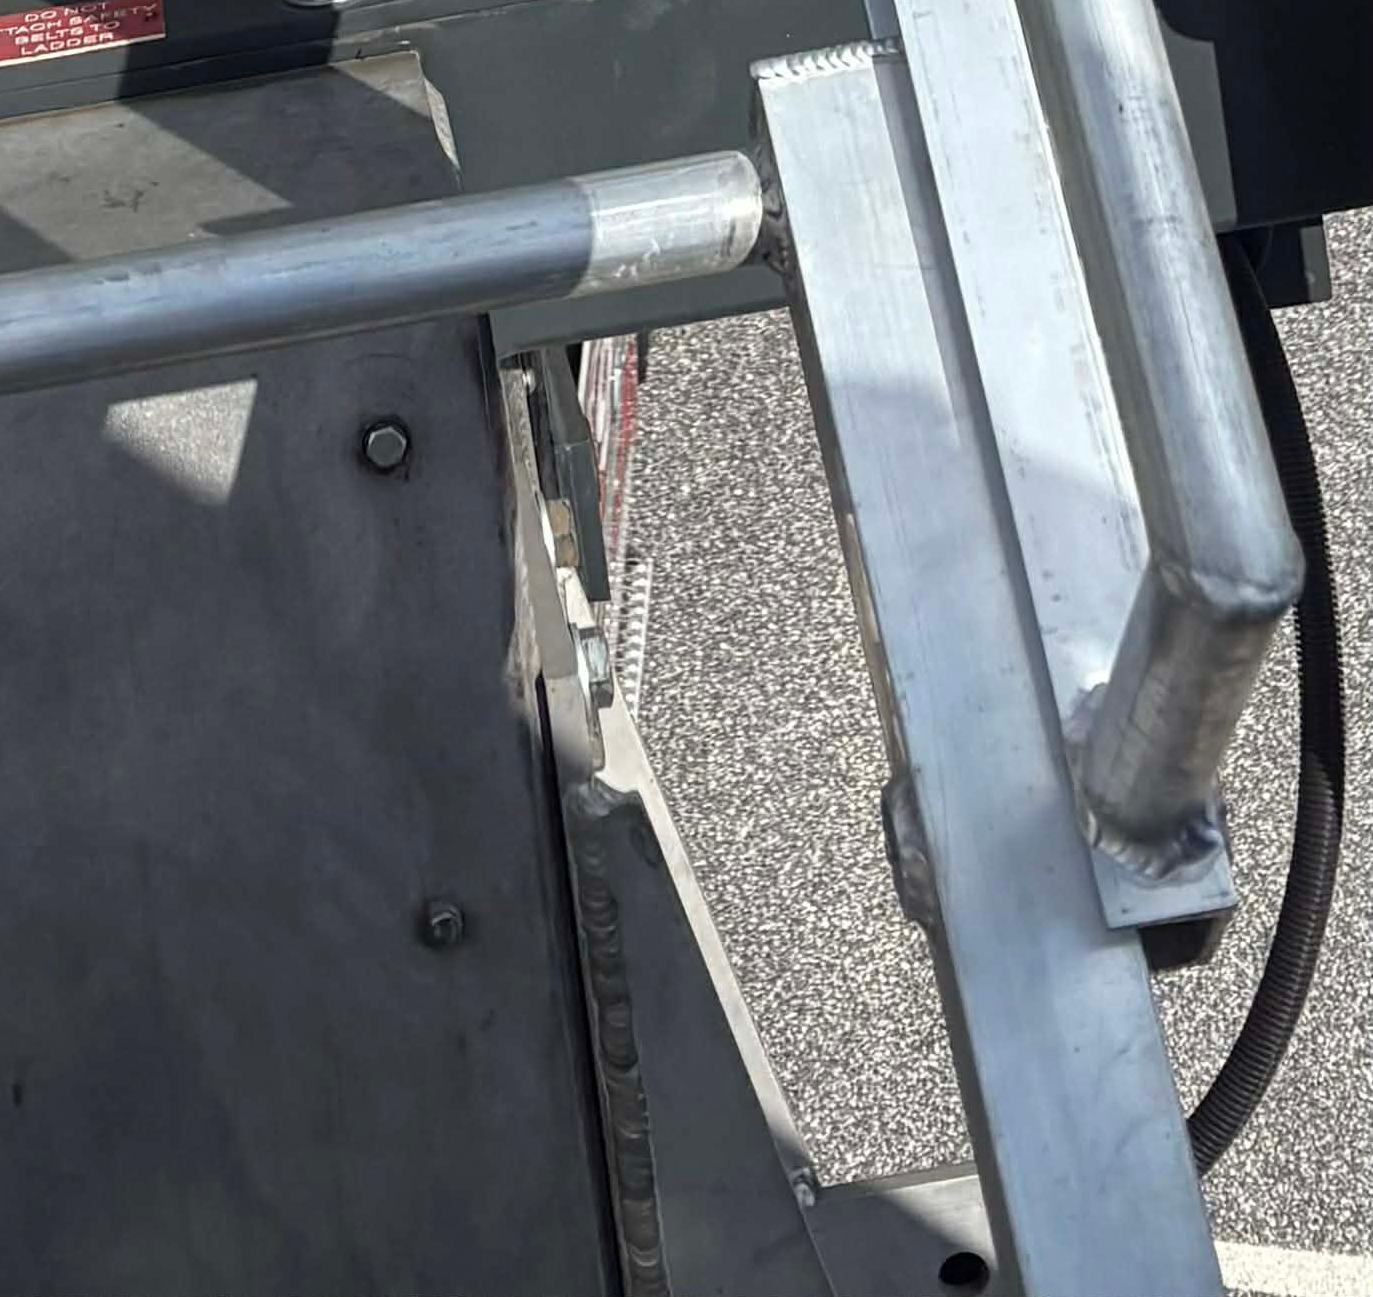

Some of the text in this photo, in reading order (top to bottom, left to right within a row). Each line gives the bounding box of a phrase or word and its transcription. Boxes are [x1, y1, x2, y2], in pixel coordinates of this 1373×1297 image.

[24, 1, 108, 23] DO NOT
[69, 3, 158, 26] SAFETY
[14, 20, 121, 46] BELTS TO
[21, 32, 114, 56] LADDER
